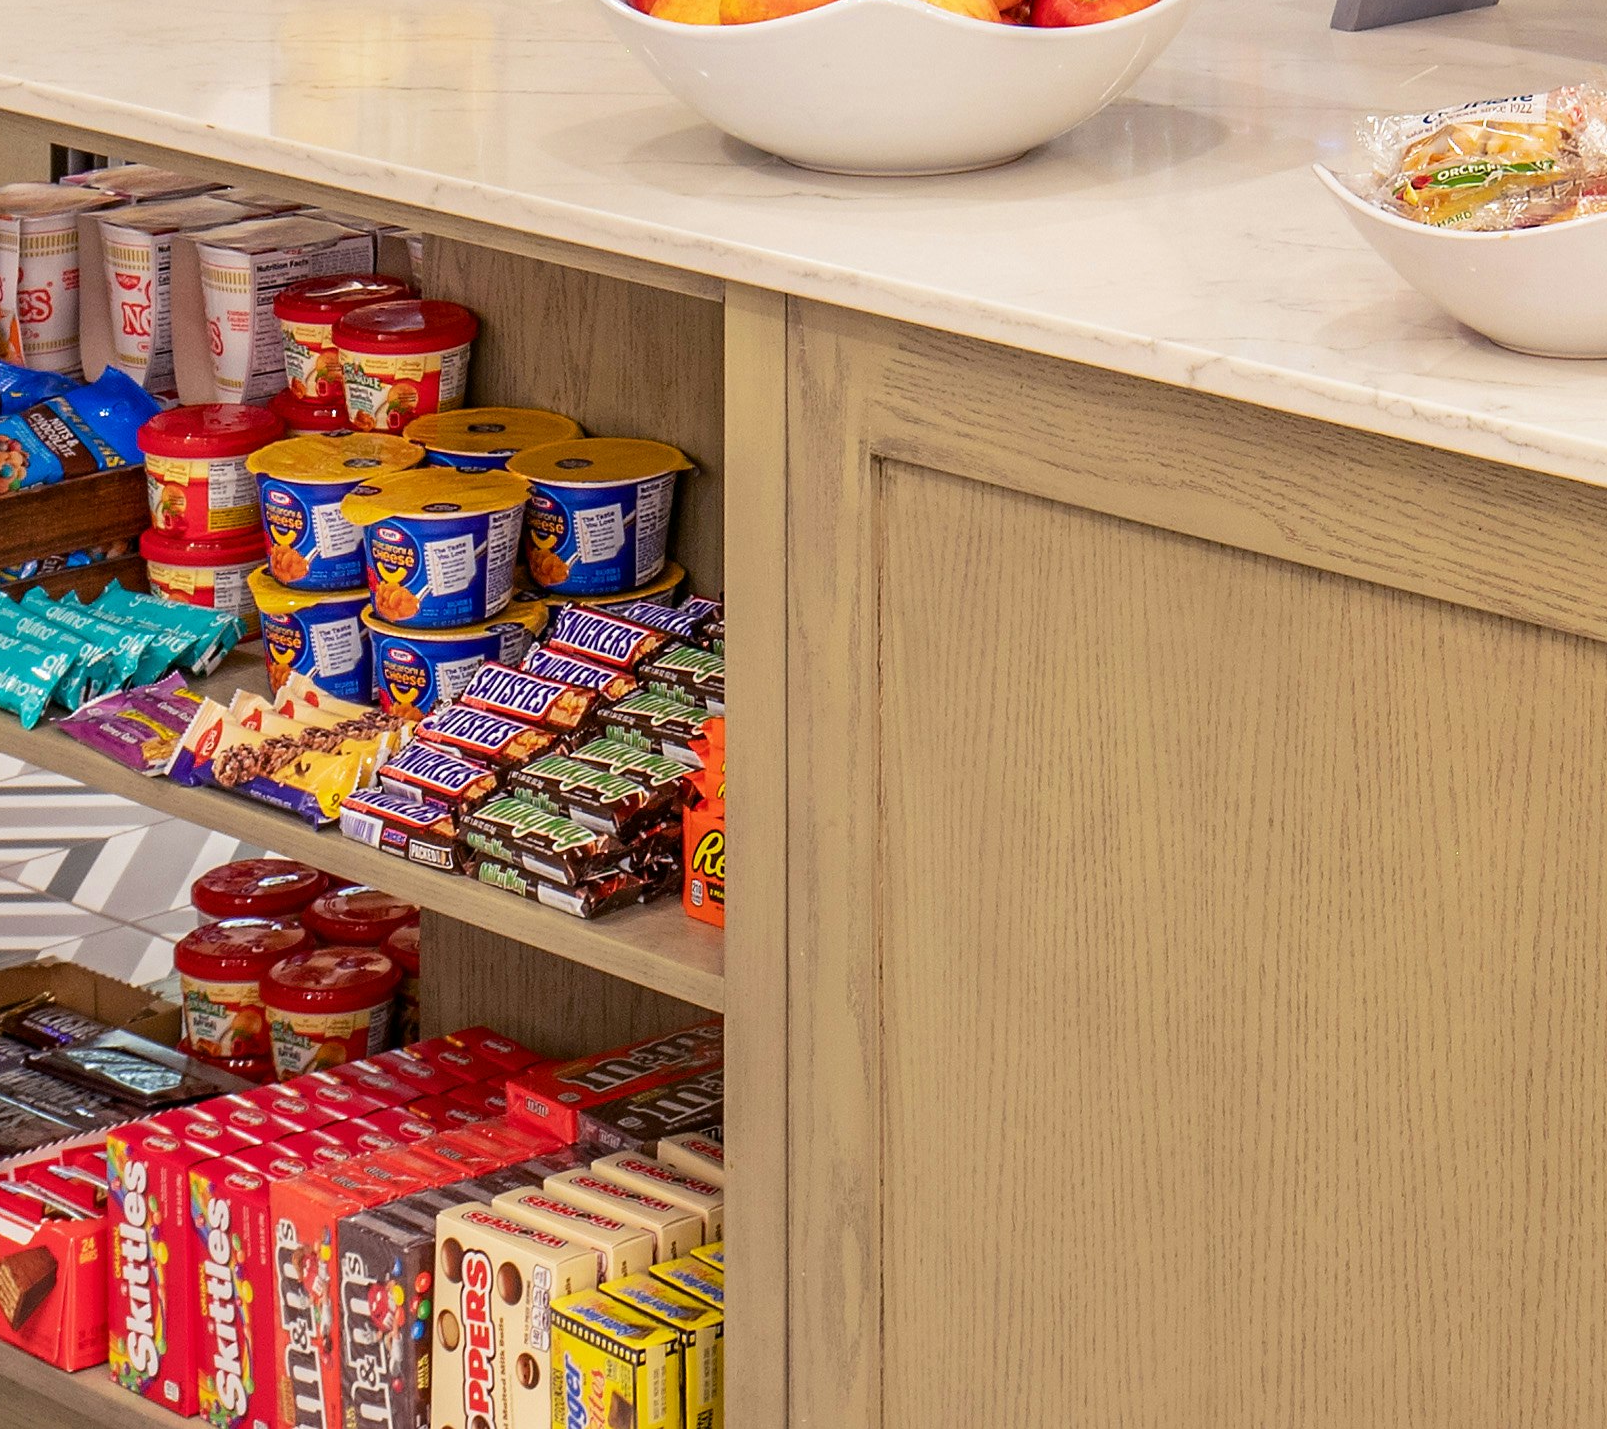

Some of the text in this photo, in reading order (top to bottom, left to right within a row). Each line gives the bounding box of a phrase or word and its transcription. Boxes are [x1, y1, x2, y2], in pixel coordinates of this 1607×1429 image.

[468, 670, 566, 711] SATISFIES
[554, 609, 633, 660] SNICKERS
[122, 1156, 162, 1379] Skittles
[198, 1195, 249, 1419] Skittles
